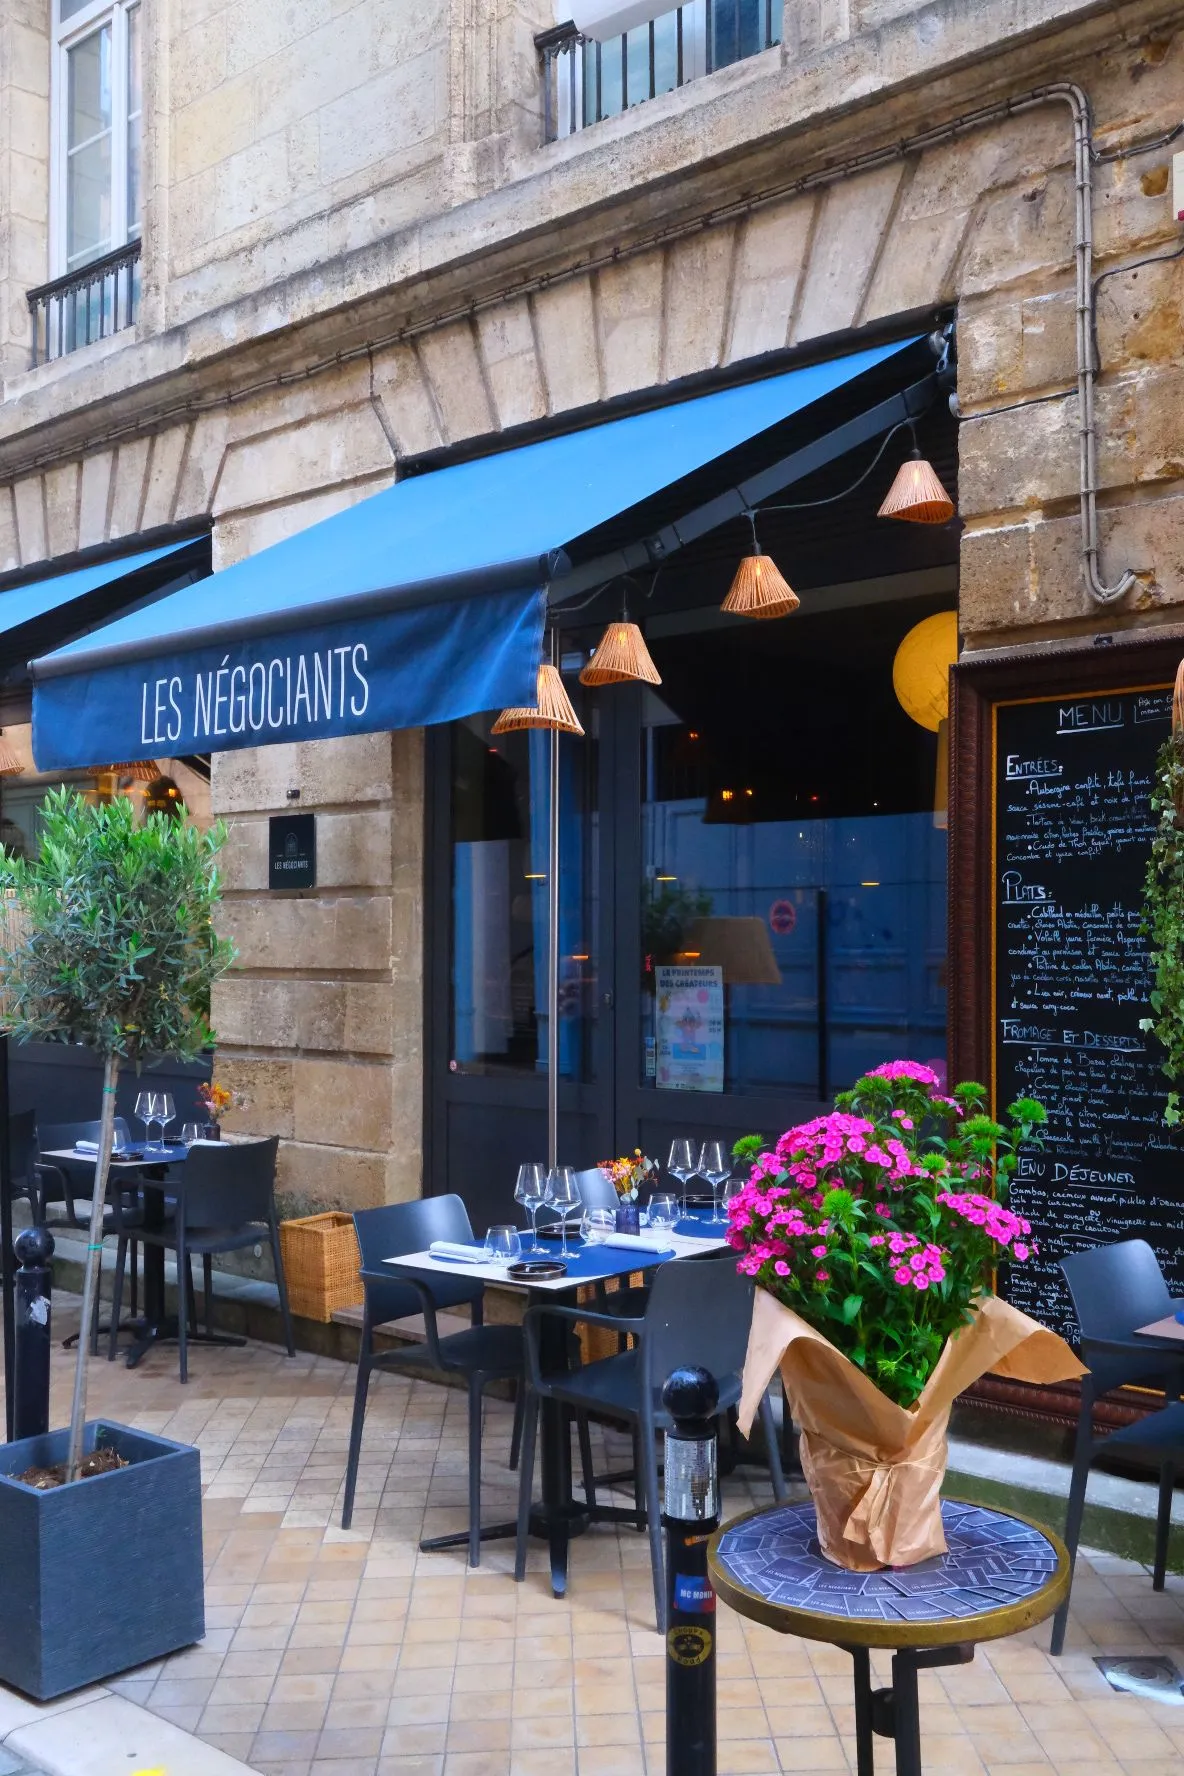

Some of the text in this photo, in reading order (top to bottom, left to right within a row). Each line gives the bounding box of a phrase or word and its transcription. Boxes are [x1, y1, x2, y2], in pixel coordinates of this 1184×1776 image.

[141, 643, 369, 744] LES NÉGOCIANTS
[1059, 703, 1123, 727] MENU
[1000, 1018, 1057, 1041] FROMAGE
[1063, 1030, 1080, 1044] ET
[1051, 1163, 1136, 1184] DÉJEUNER
